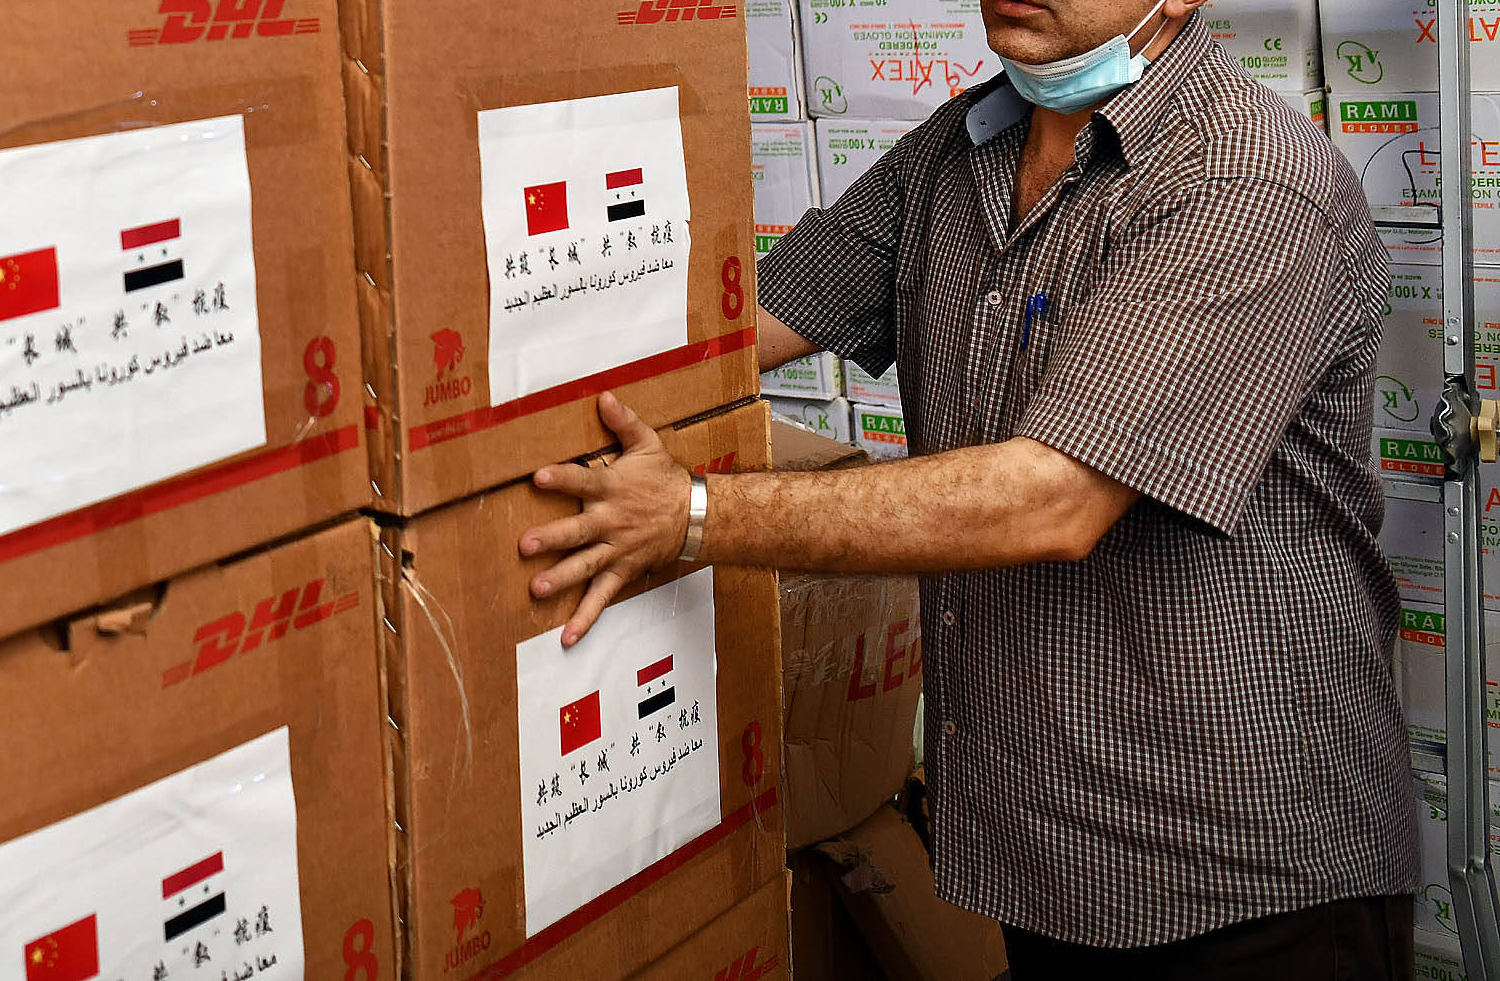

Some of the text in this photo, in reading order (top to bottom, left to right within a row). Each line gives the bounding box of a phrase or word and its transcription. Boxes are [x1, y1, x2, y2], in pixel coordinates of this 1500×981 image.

[894, 31, 964, 41] EXAMINATION
[870, 60, 950, 82] LATEX
[1347, 103, 1411, 118] RAMI
[721, 255, 745, 321] 8
[304, 336, 340, 418] 8
[424, 377, 471, 408] JUMBO
[866, 416, 906, 432] RAM
[1388, 442, 1444, 459] RAM
[1387, 462, 1444, 475] GLOVE
[192, 579, 335, 675] DHL
[650, 746, 676, 781] فيروس
[741, 721, 764, 787] 8
[620, 766, 647, 793] كورونا
[537, 812, 561, 840] الجديد
[564, 797, 588, 830] العظيم
[343, 919, 378, 981] 8
[443, 930, 491, 975] JUMBO
